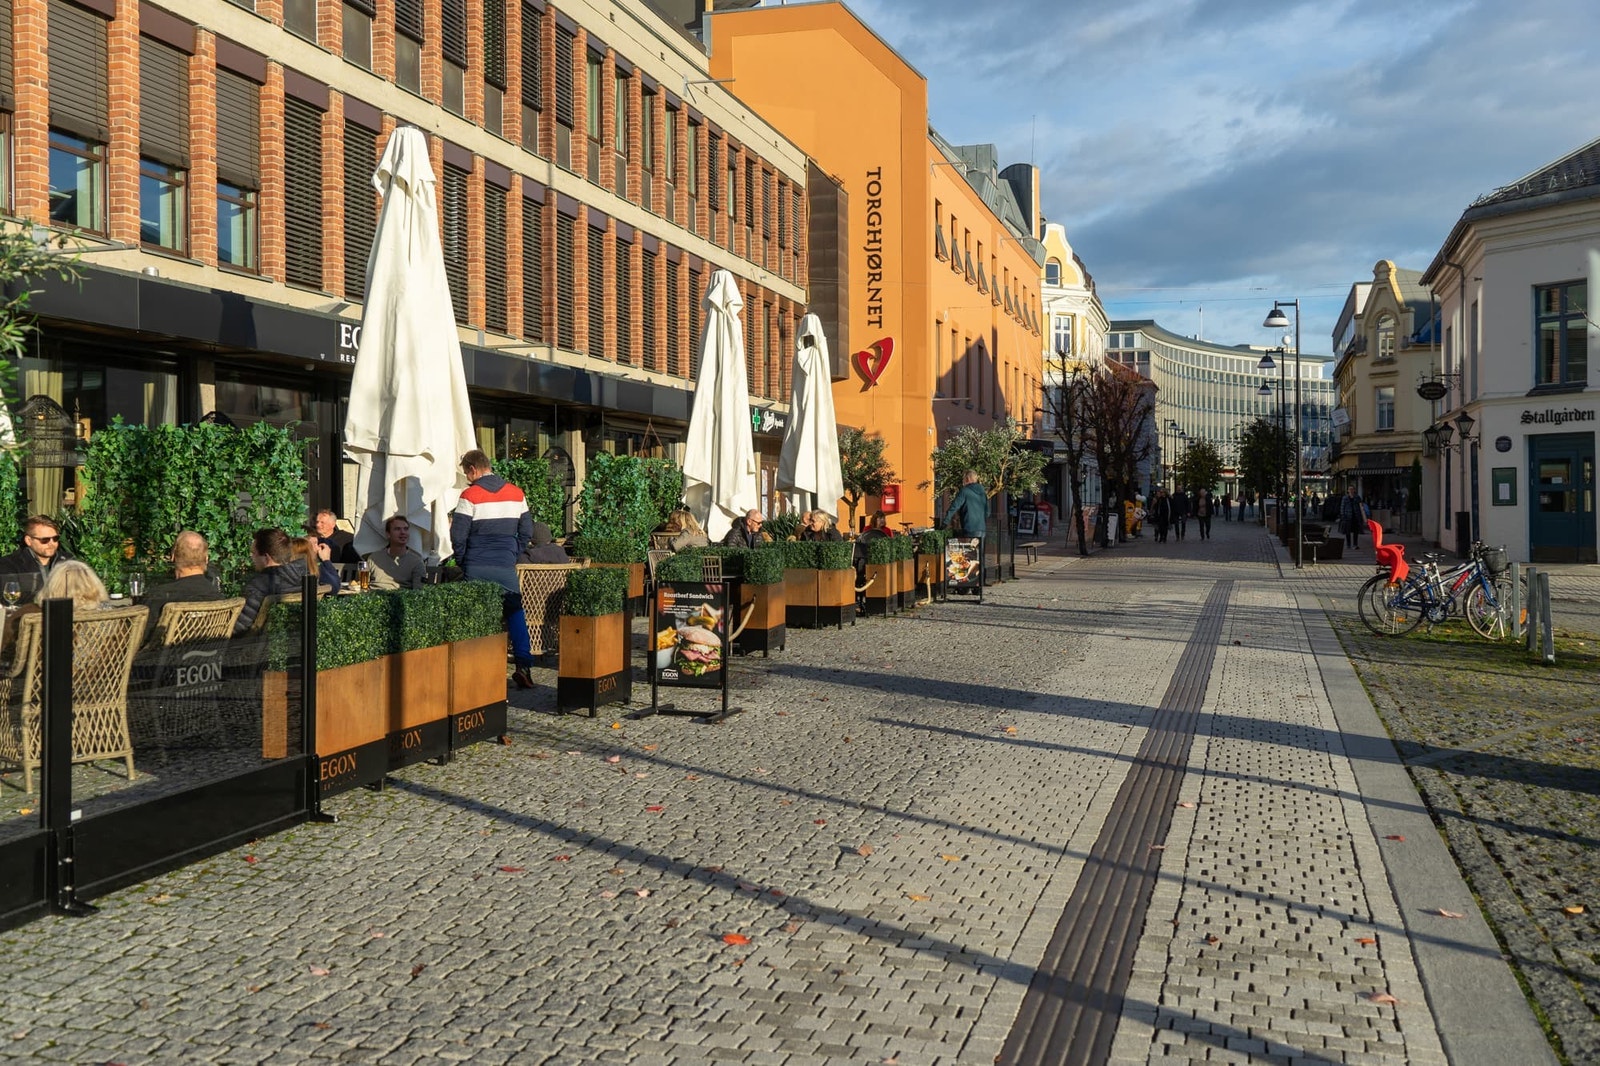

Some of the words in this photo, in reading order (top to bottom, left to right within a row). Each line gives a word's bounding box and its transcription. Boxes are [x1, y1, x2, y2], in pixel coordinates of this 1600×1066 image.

[863, 166, 883, 329] TORGHJØRNET
[340, 353, 356, 364] RES
[1520, 407, 1595, 426] Stallgården
[176, 661, 223, 687] EGON
[598, 676, 617, 694] EGON
[457, 710, 486, 733] EGON
[320, 752, 357, 782] EGON
